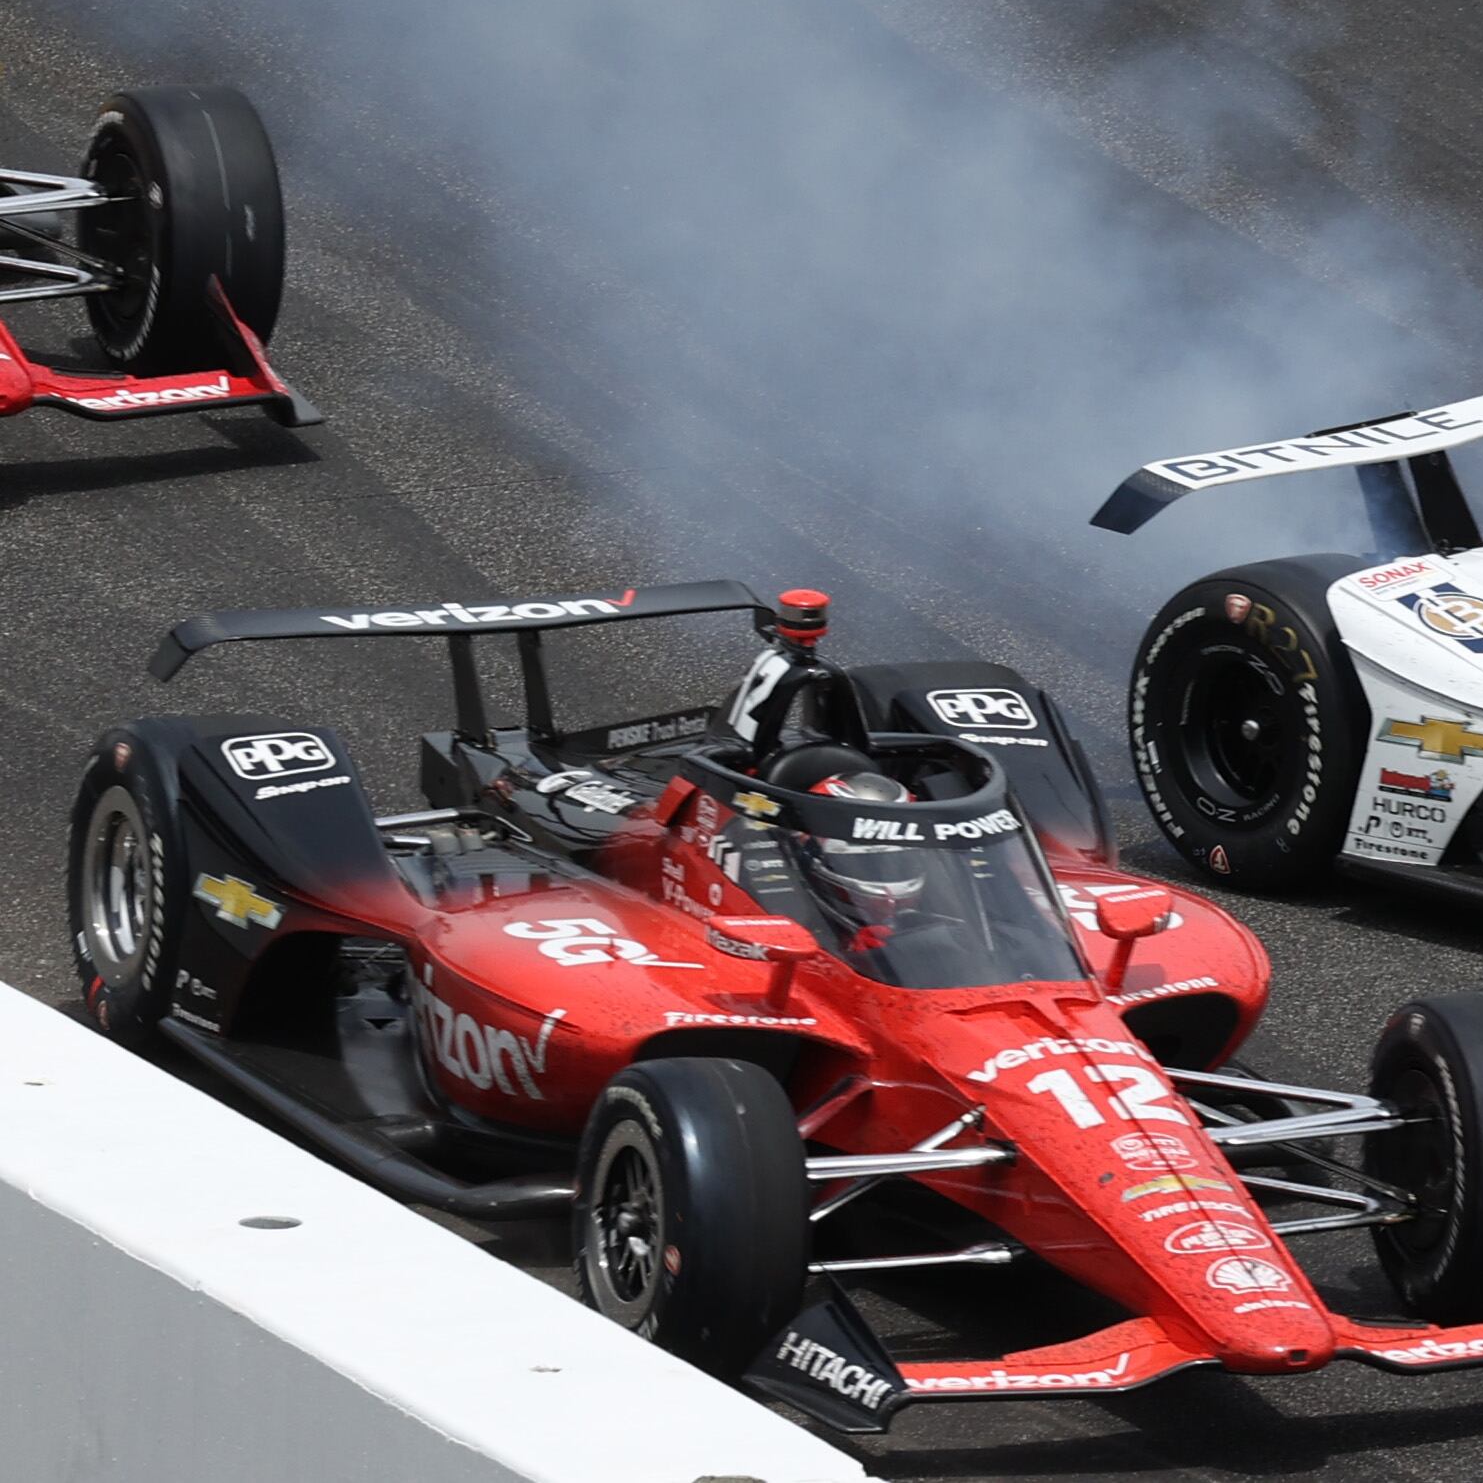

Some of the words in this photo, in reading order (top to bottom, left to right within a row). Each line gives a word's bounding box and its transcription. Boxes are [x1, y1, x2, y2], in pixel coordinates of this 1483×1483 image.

[1161, 410, 1483, 483] BITNILE
[1357, 561, 1428, 590] SONAX
[320, 595, 623, 631] verizon
[728, 649, 792, 743] 12
[943, 693, 1026, 724] PPG
[226, 734, 325, 773] PPG
[608, 726, 650, 750] PENSKE
[958, 732, 1049, 747] Snap-on
[1286, 681, 1323, 836] Firestone
[255, 774, 351, 801] Snap-on
[852, 817, 926, 842] WILL
[933, 808, 1022, 841] POWER
[1372, 796, 1447, 825] HURCO
[1353, 836, 1430, 861] Firestone
[501, 917, 645, 967] 5G
[705, 929, 770, 960] Mazak
[1104, 974, 1220, 1007] Firestone
[662, 1010, 818, 1027] Firestone
[965, 1037, 1158, 1084] verizon
[1026, 1063, 1192, 1131] 12
[775, 1331, 892, 1411] HITACHI
[904, 1370, 1110, 1390] verizon
